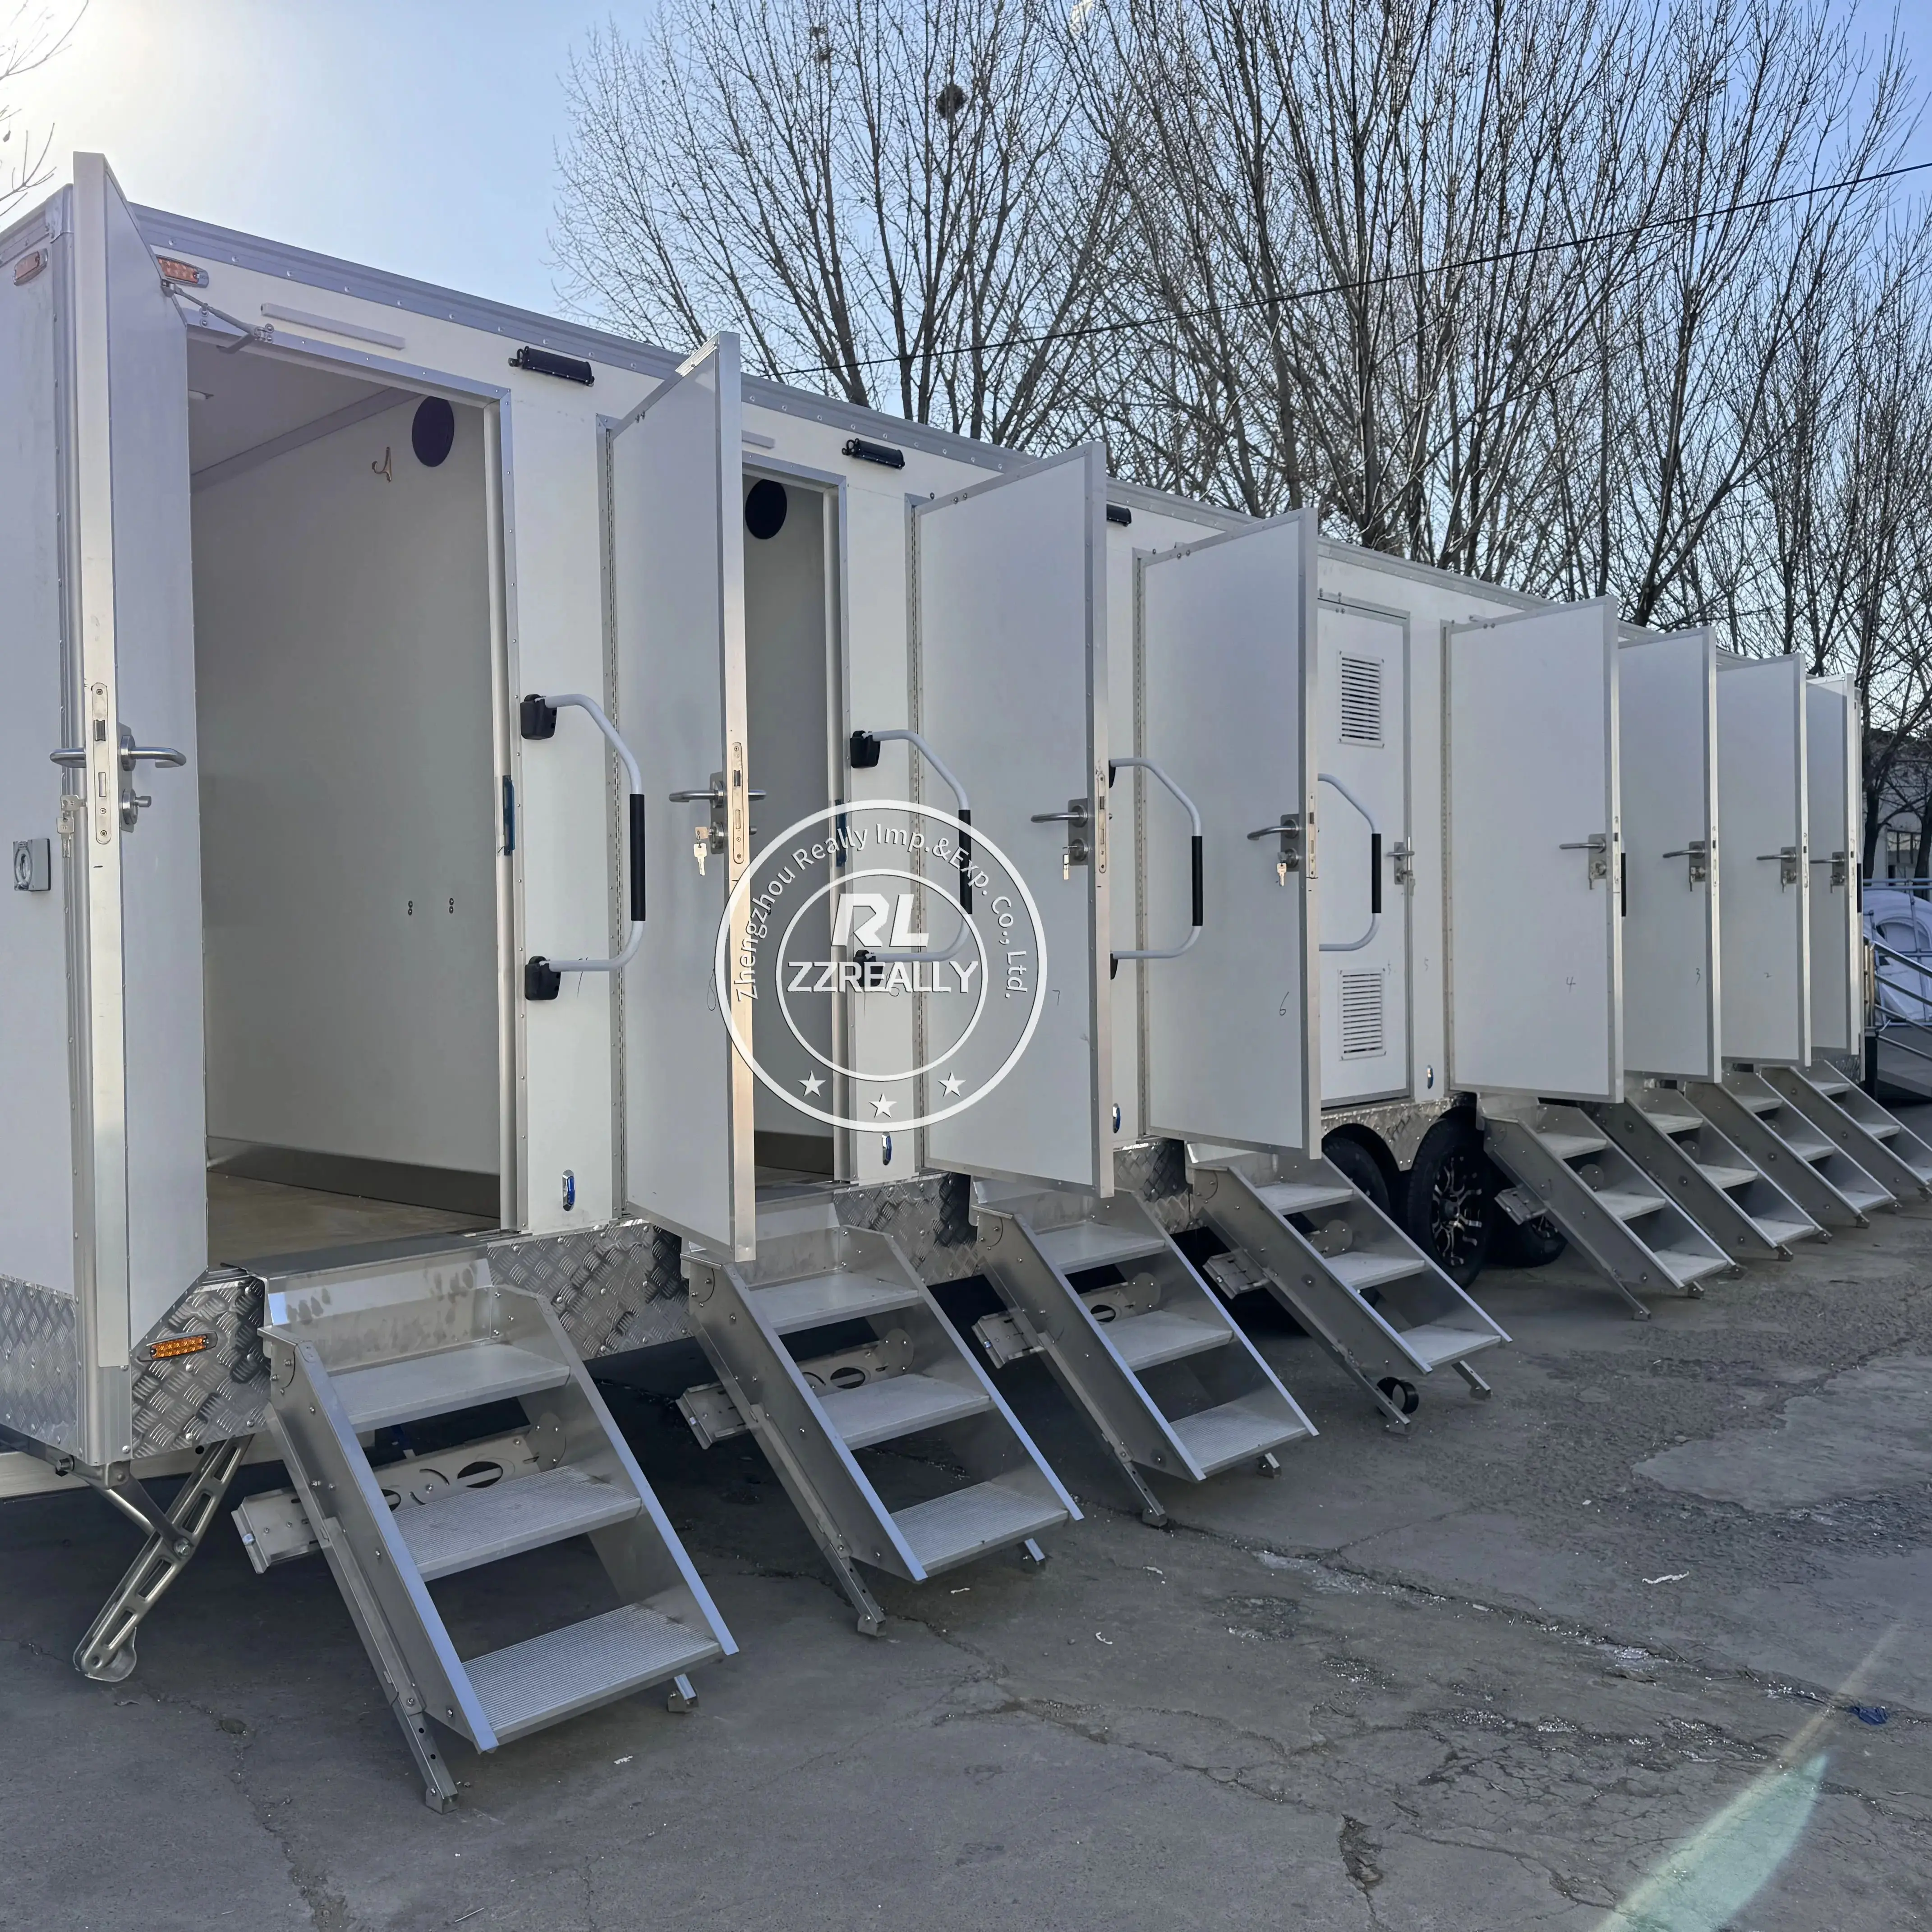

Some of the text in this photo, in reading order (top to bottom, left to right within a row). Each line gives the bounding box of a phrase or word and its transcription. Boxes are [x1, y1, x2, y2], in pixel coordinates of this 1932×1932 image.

[1565, 976, 1576, 993] 4
[1052, 989, 1060, 1006] 7
[1279, 991, 1289, 1016] 6
